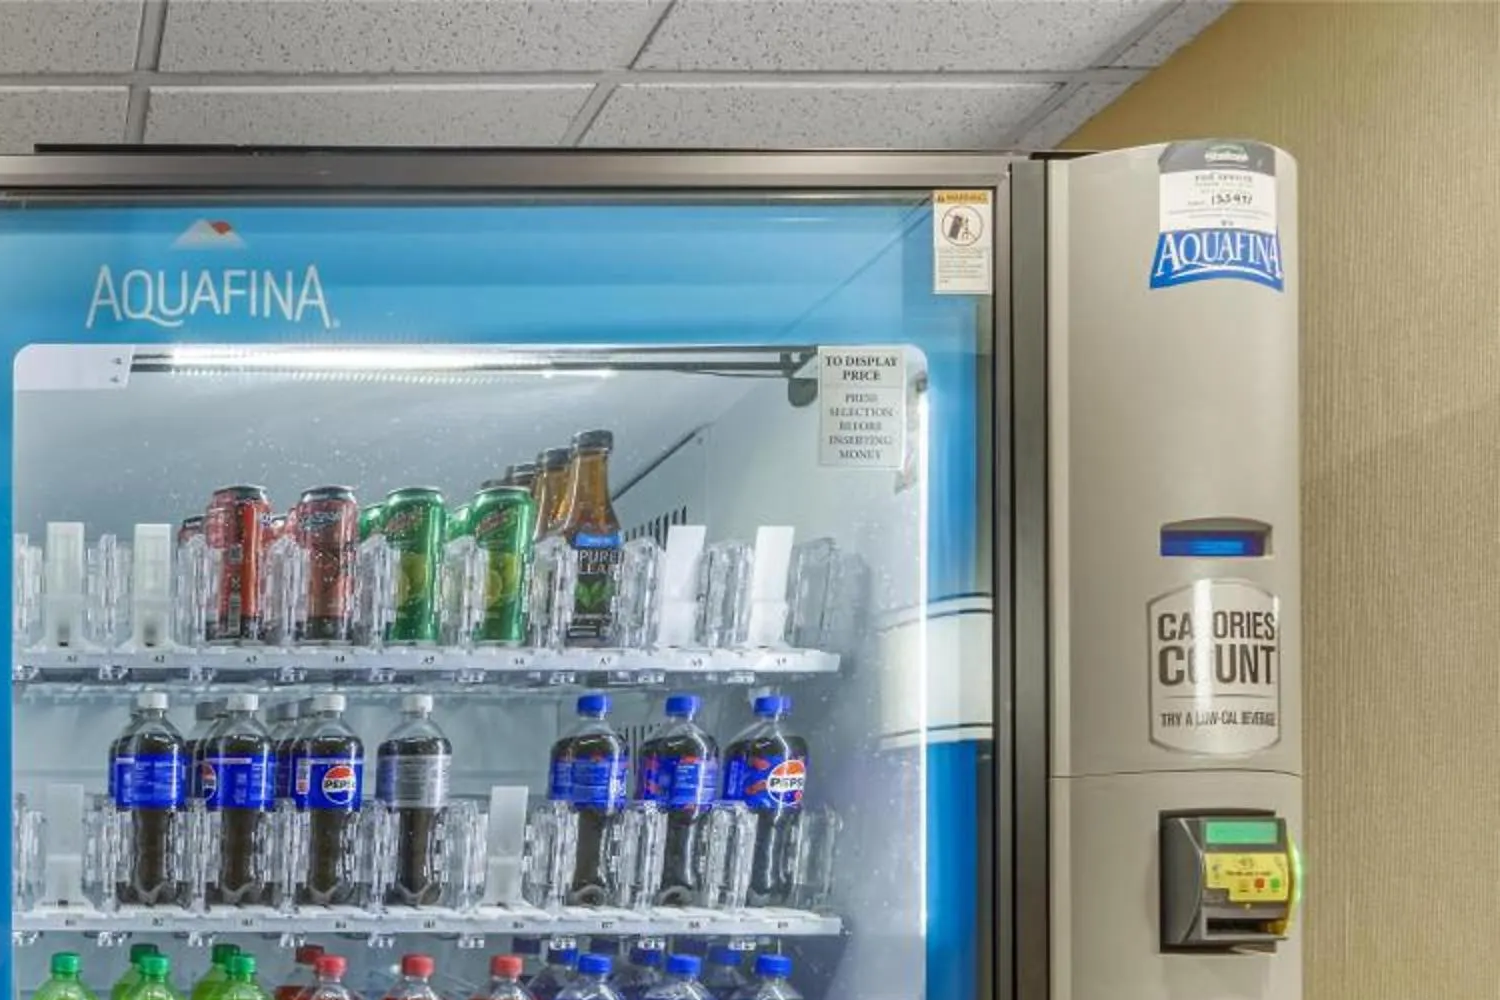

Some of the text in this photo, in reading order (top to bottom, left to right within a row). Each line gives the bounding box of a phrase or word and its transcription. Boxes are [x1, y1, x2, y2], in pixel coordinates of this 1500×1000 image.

[1154, 232, 1283, 279] AQUAFINA
[86, 264, 332, 329] AQUAFINA
[826, 355, 898, 367] TO DISPLAY
[843, 371, 881, 381] PRICE
[828, 435, 893, 445] INSERTING
[839, 450, 884, 460] MONEY
[1157, 611, 1275, 641] CAORIES
[1161, 712, 1182, 727] TRY
[1185, 712, 1194, 726] A
[769, 777, 805, 789] PEPS
